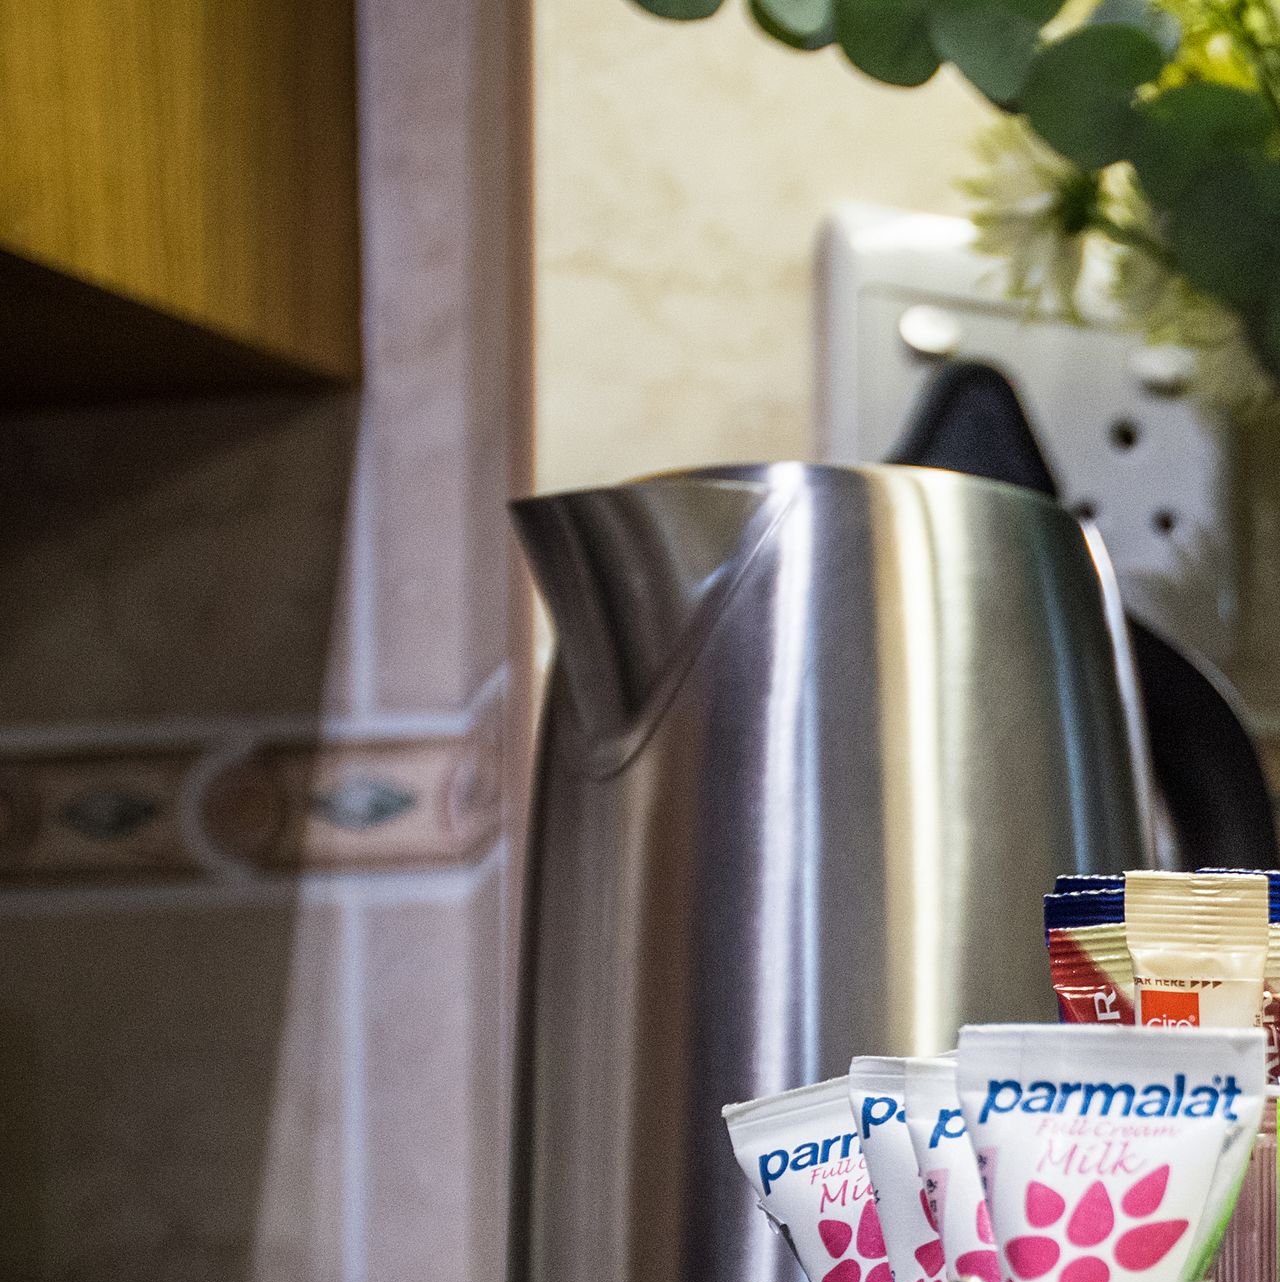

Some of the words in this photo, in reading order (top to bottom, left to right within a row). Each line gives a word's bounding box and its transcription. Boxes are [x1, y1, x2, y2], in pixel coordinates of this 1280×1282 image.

[978, 1072, 1243, 1125] parmalat
[810, 1157, 856, 1186] Full
[1036, 1138, 1149, 1177] Milk
